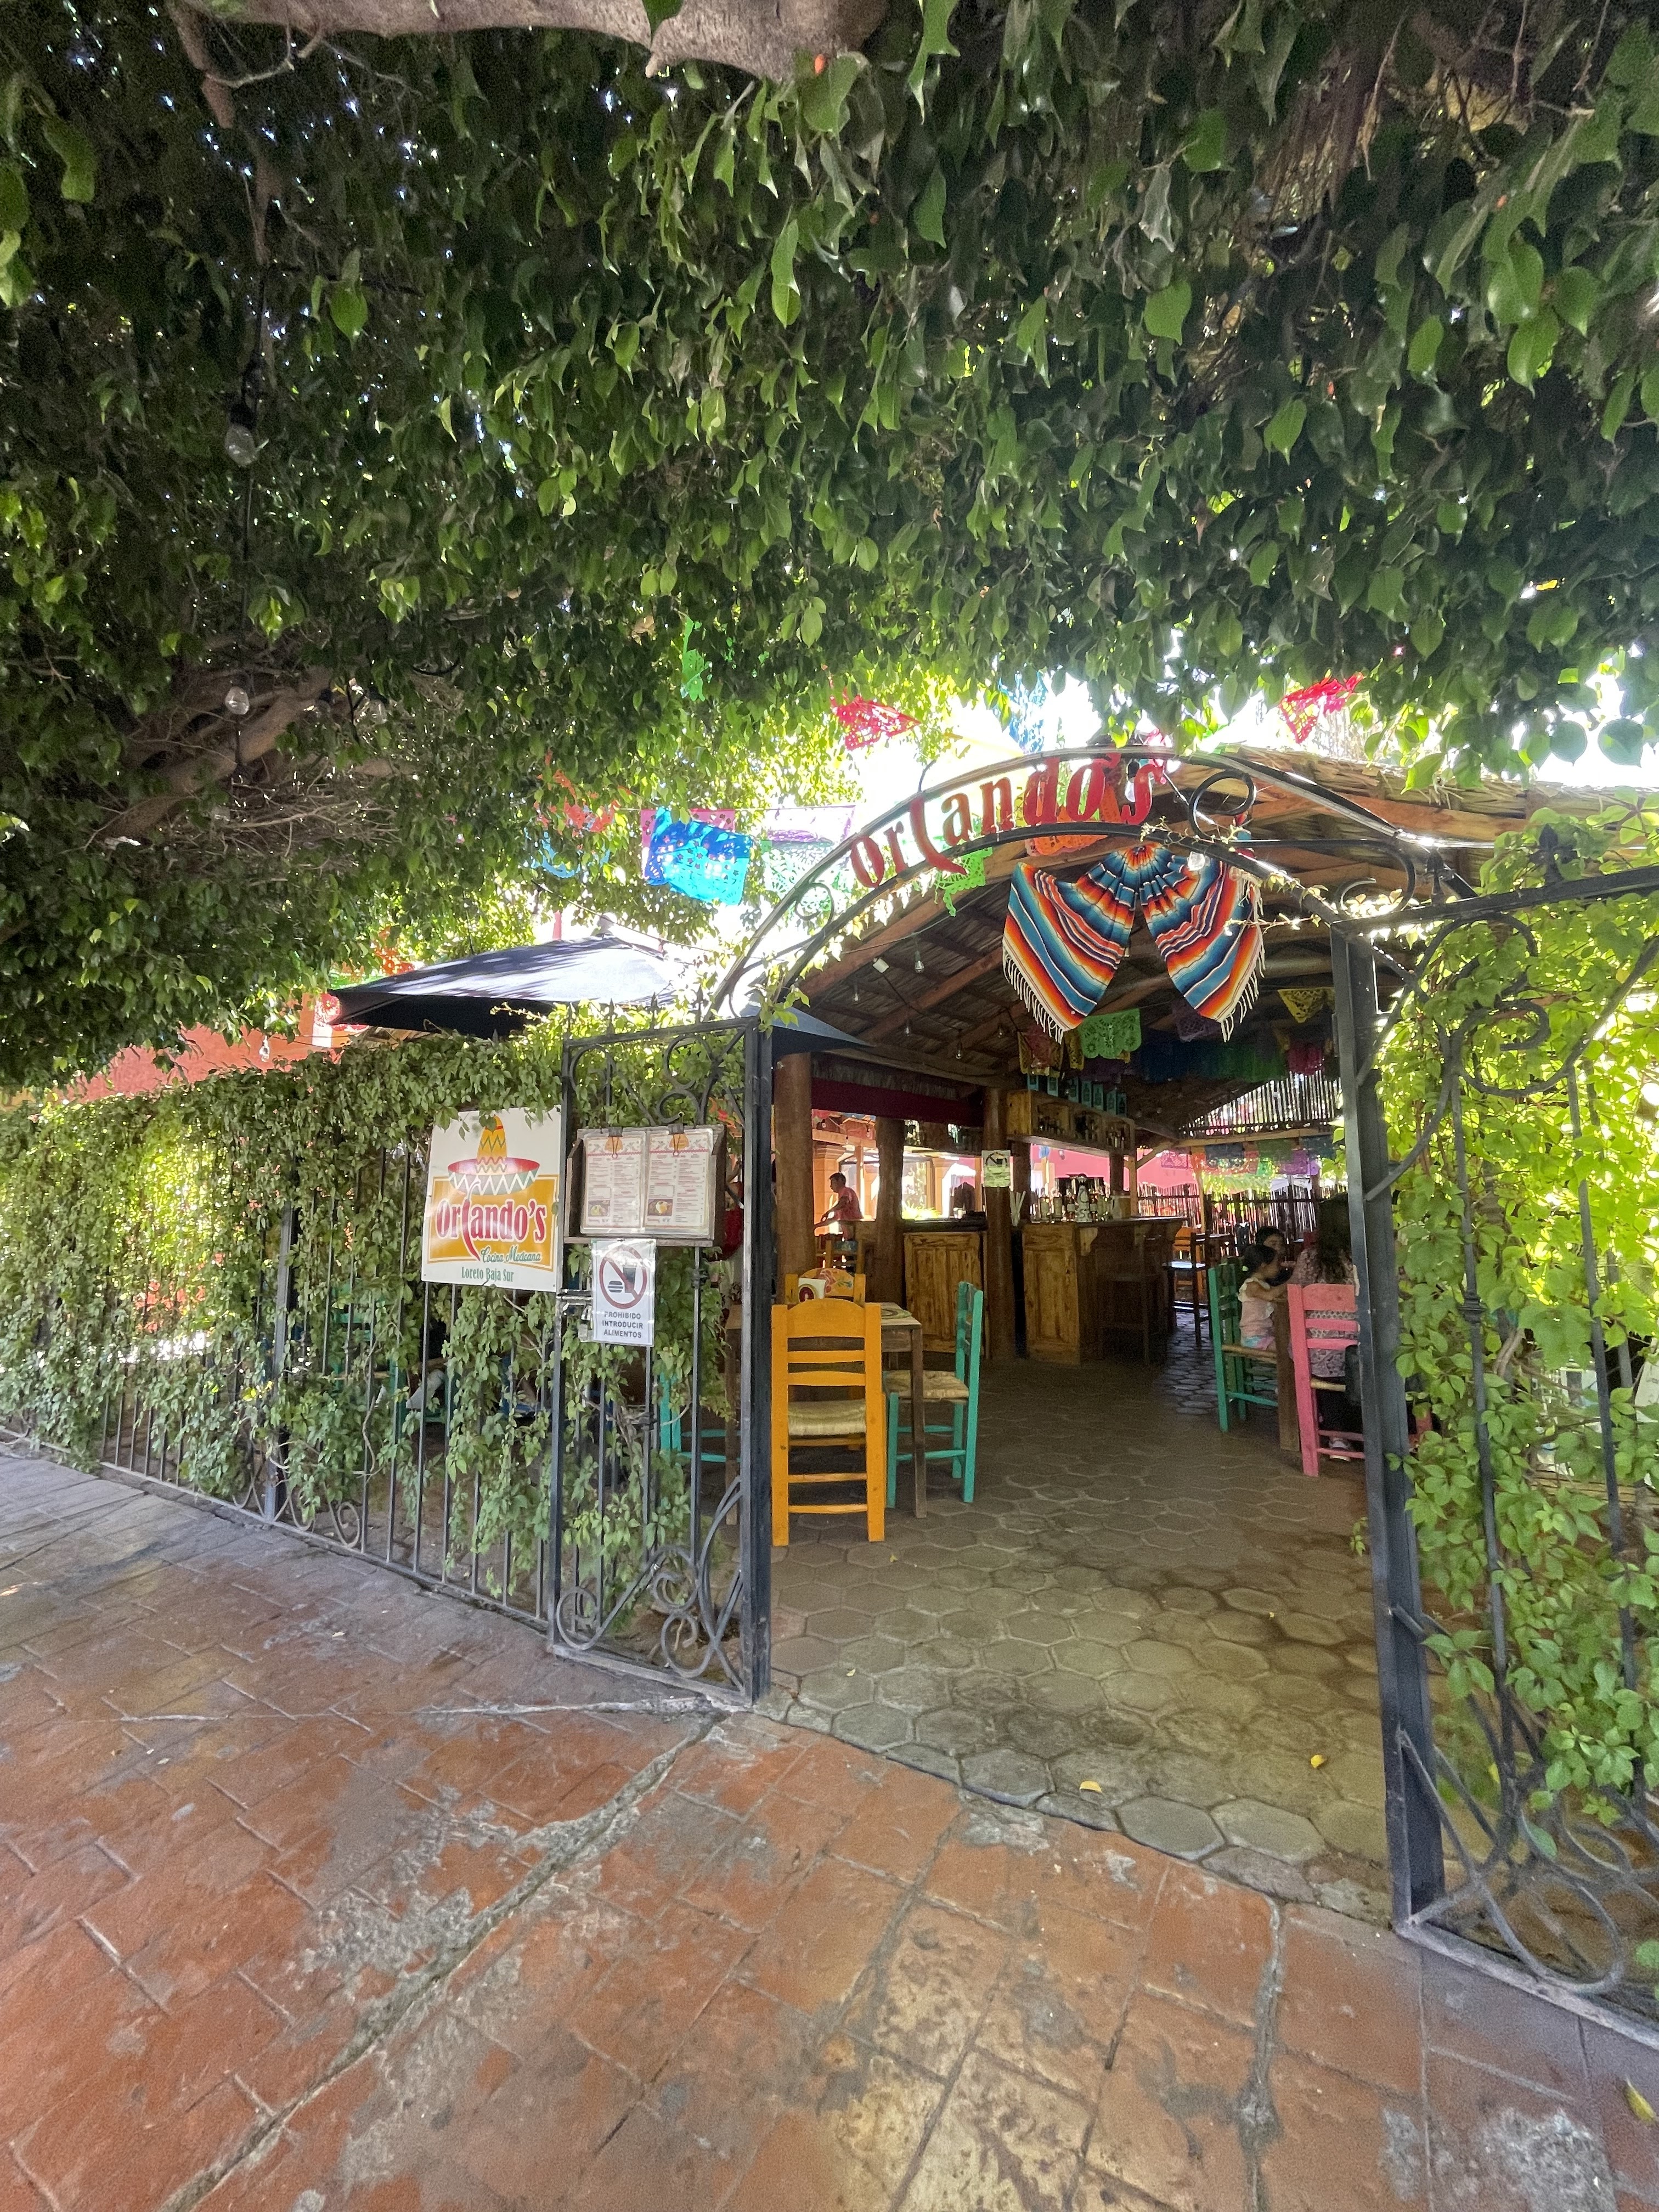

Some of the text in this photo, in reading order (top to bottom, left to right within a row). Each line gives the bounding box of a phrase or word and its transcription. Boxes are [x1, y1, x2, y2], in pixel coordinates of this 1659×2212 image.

[436, 1198, 546, 1261] Orlando's
[481, 1245, 541, 1262] Cocina Mexicana
[461, 1266, 514, 1282] Loreto Baja Sur
[604, 1311, 641, 1319] PROHIBIDO
[602, 1320, 643, 1329] INTRODUCIR
[603, 1329, 641, 1339] ALIMENTOS
